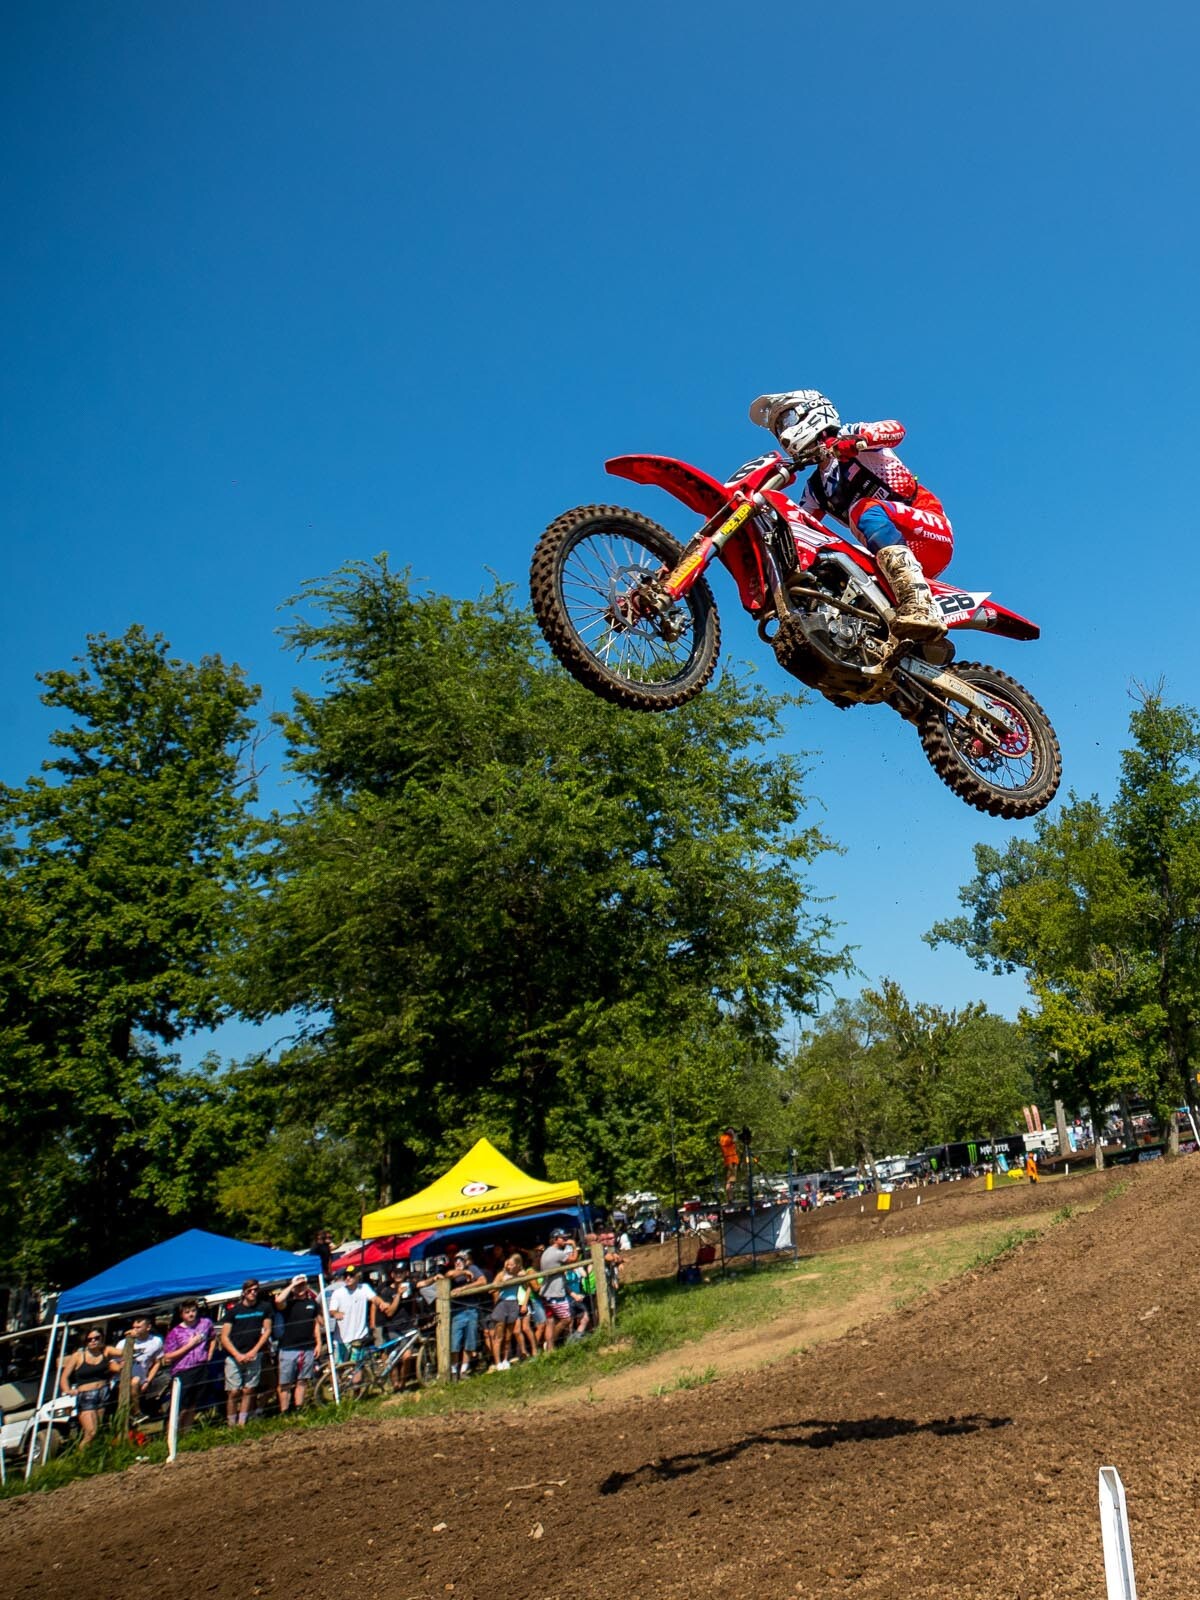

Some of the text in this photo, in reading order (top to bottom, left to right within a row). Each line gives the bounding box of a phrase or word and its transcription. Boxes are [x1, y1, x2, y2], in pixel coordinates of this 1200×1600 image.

[923, 530, 952, 544] HONDA
[935, 593, 976, 614] 26
[943, 611, 971, 625] MOTUL
[448, 1202, 510, 1219] DUNLOP
